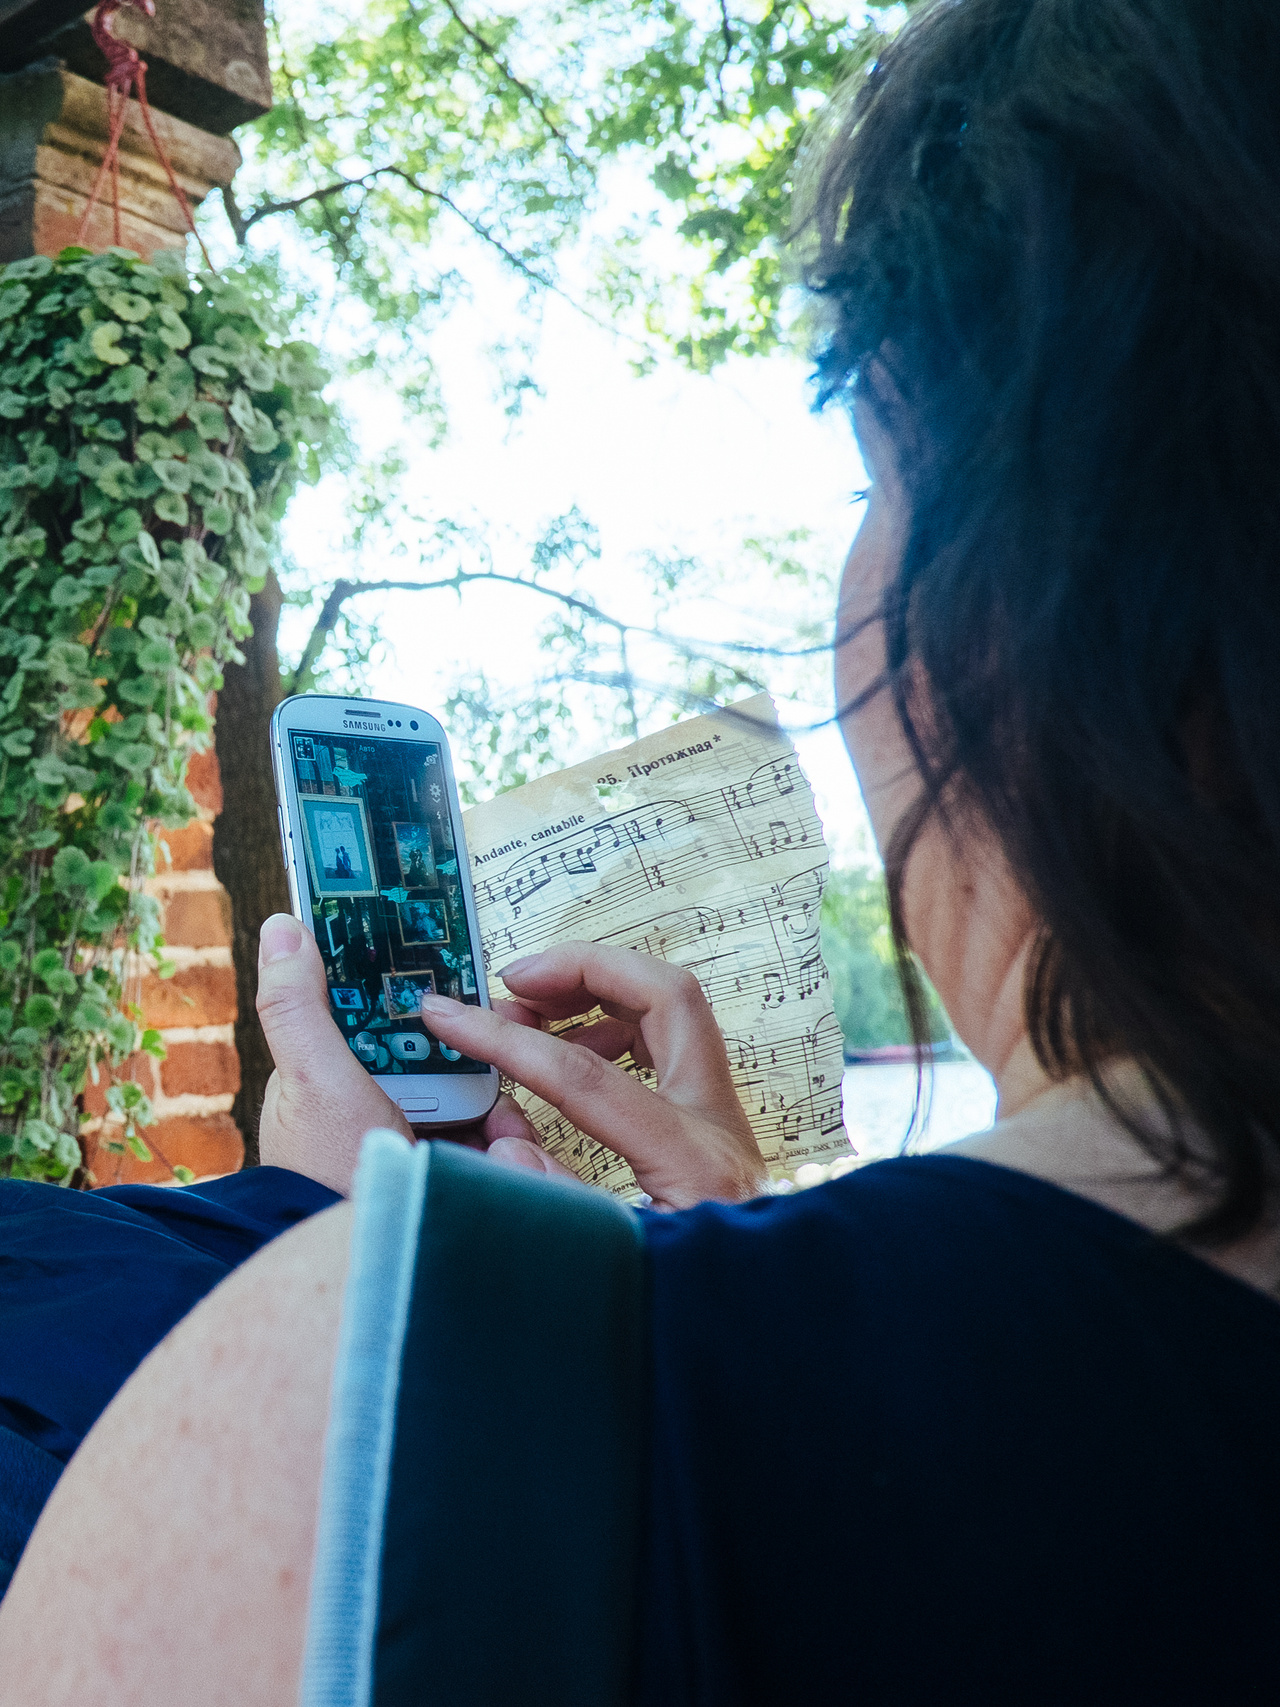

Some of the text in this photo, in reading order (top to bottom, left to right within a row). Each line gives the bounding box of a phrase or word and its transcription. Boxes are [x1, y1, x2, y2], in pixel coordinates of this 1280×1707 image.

[342, 719, 386, 732] SAMSUNG
[474, 814, 586, 867] Andante, cantabile
